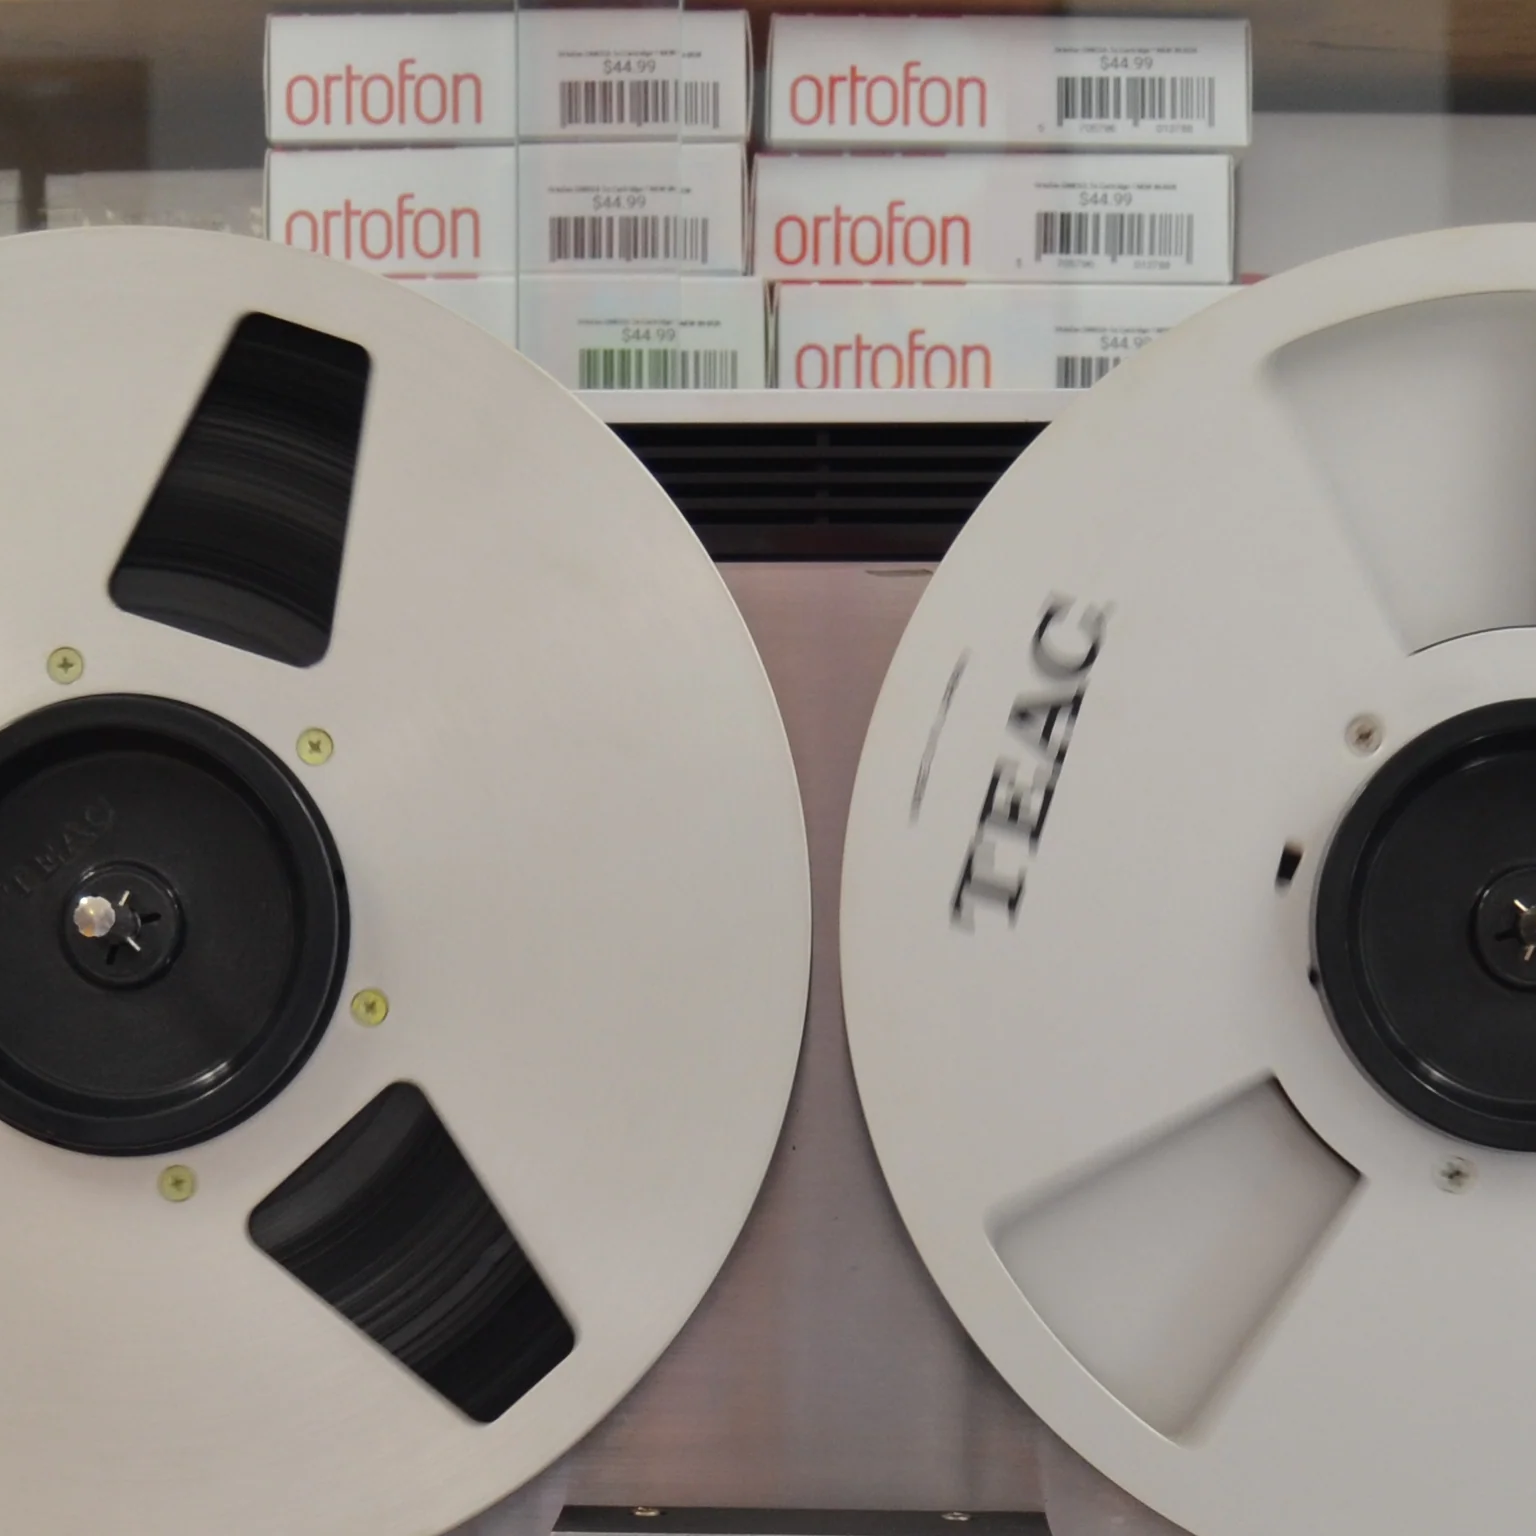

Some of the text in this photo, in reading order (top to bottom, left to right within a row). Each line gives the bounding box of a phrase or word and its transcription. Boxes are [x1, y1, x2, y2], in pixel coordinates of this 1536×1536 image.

[284, 58, 483, 128] ortofon
[603, 59, 657, 75] $44.99
[1100, 56, 1154, 71] $44.99
[788, 61, 988, 129] ortofon
[284, 193, 482, 261] ortofon
[592, 195, 647, 210] $44.99
[1079, 191, 1133, 207] $44.99
[773, 200, 972, 268] ortofon
[622, 328, 676, 343] $44.99
[794, 328, 992, 389] ortofon
[949, 588, 1116, 935] TEAC
